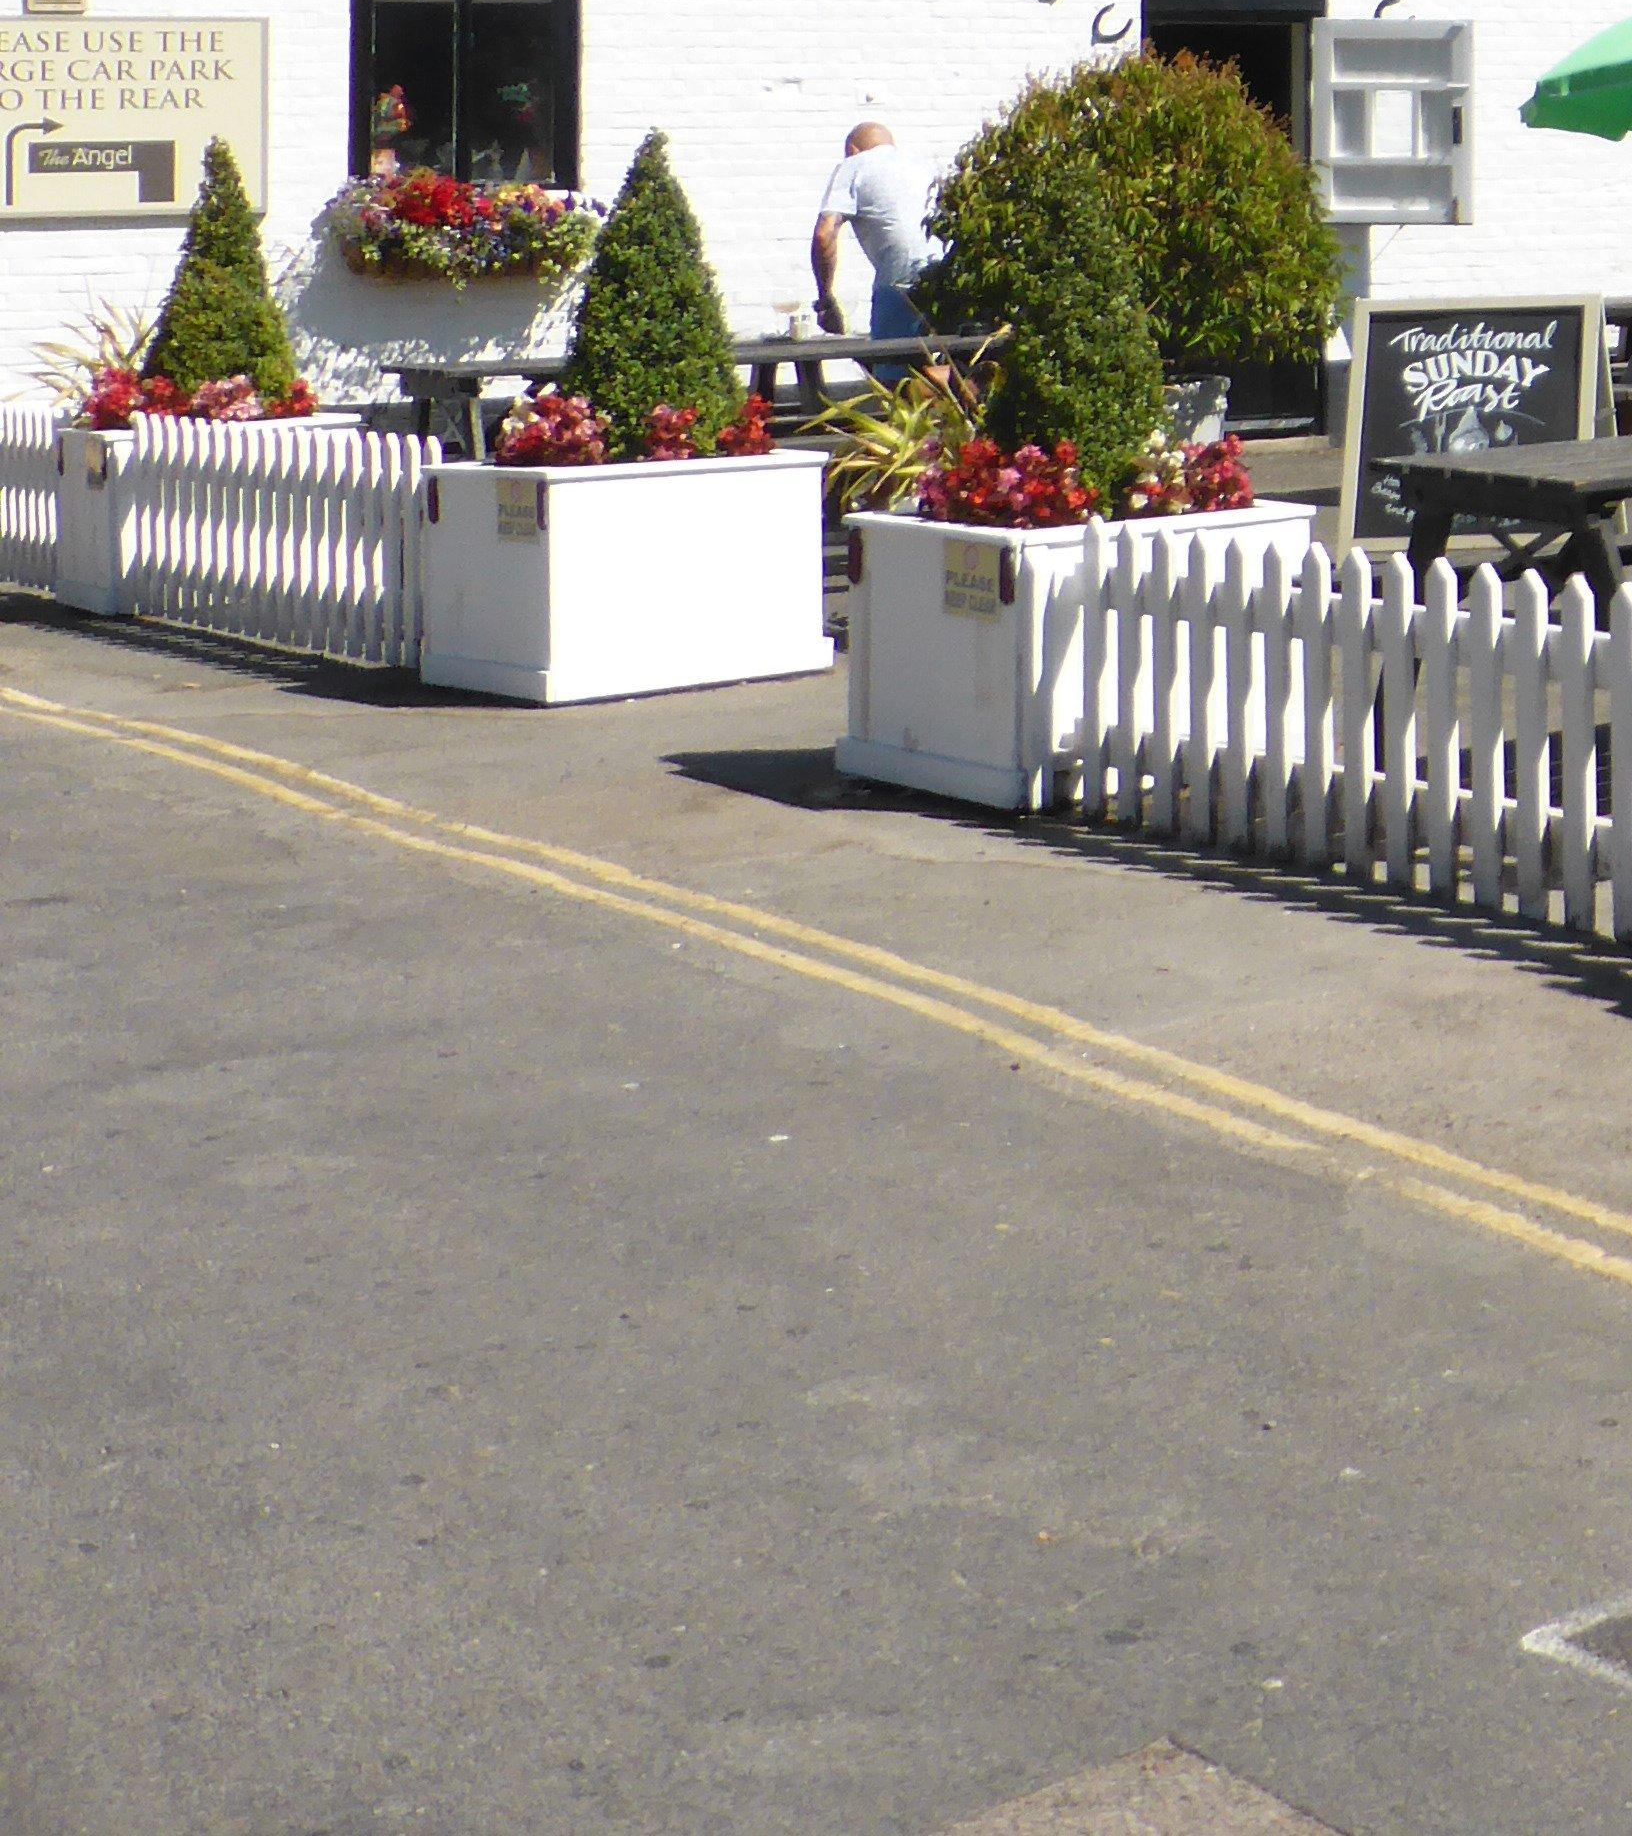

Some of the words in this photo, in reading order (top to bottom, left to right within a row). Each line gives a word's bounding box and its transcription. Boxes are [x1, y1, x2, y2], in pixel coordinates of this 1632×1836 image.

[0, 30, 70, 53] EASE
[83, 30, 143, 53] USE
[155, 30, 224, 53] THE
[0, 59, 54, 82] RGE
[67, 59, 136, 82] CAR
[150, 59, 235, 81] PARK
[0, 88, 23, 111] O
[35, 88, 105, 111] THE
[119, 87, 207, 110] REAR
[71, 144, 133, 170] Angel
[1389, 319, 1558, 353] Traditional
[1402, 349, 1550, 393] SUNDAY
[1413, 378, 1522, 423] Roast
